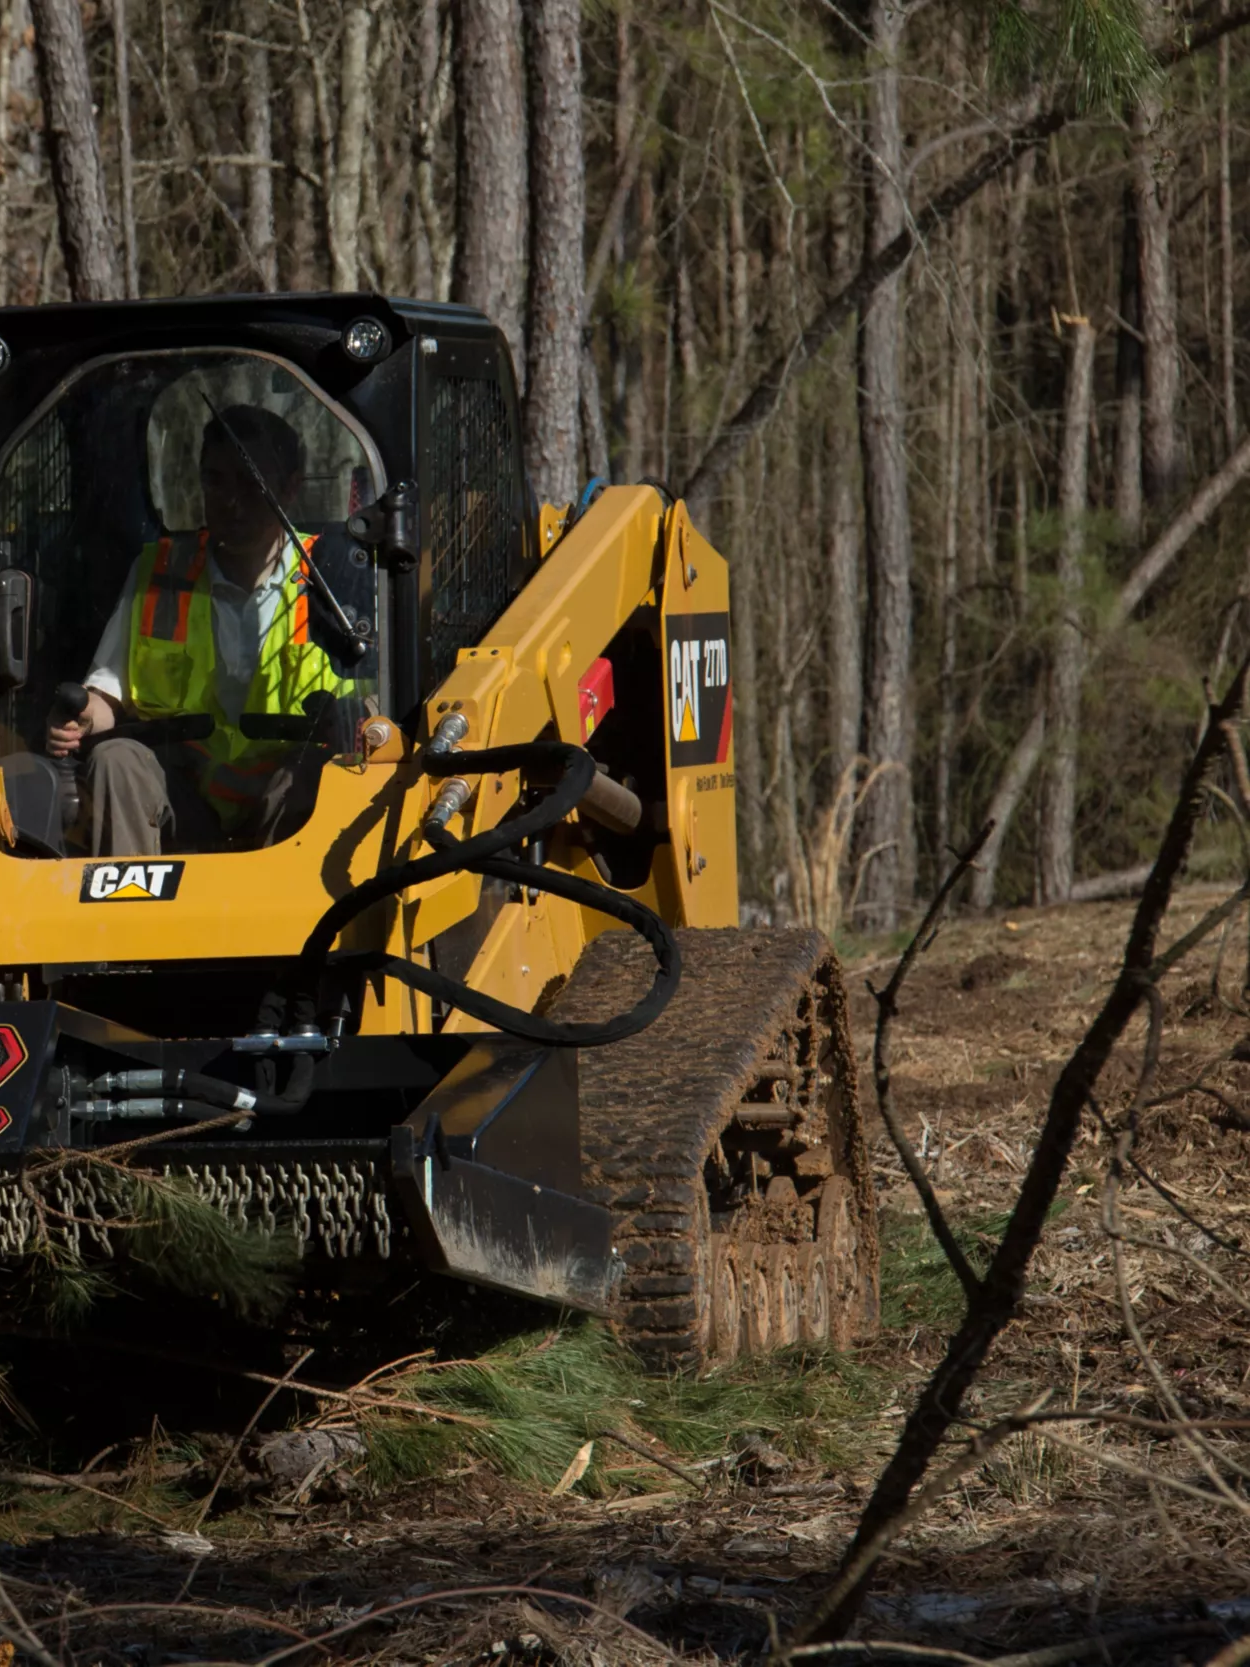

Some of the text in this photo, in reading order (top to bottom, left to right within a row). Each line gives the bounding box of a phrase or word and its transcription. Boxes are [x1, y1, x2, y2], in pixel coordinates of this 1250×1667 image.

[670, 638, 727, 742] CAT 277D
[89, 864, 174, 899] CAT
